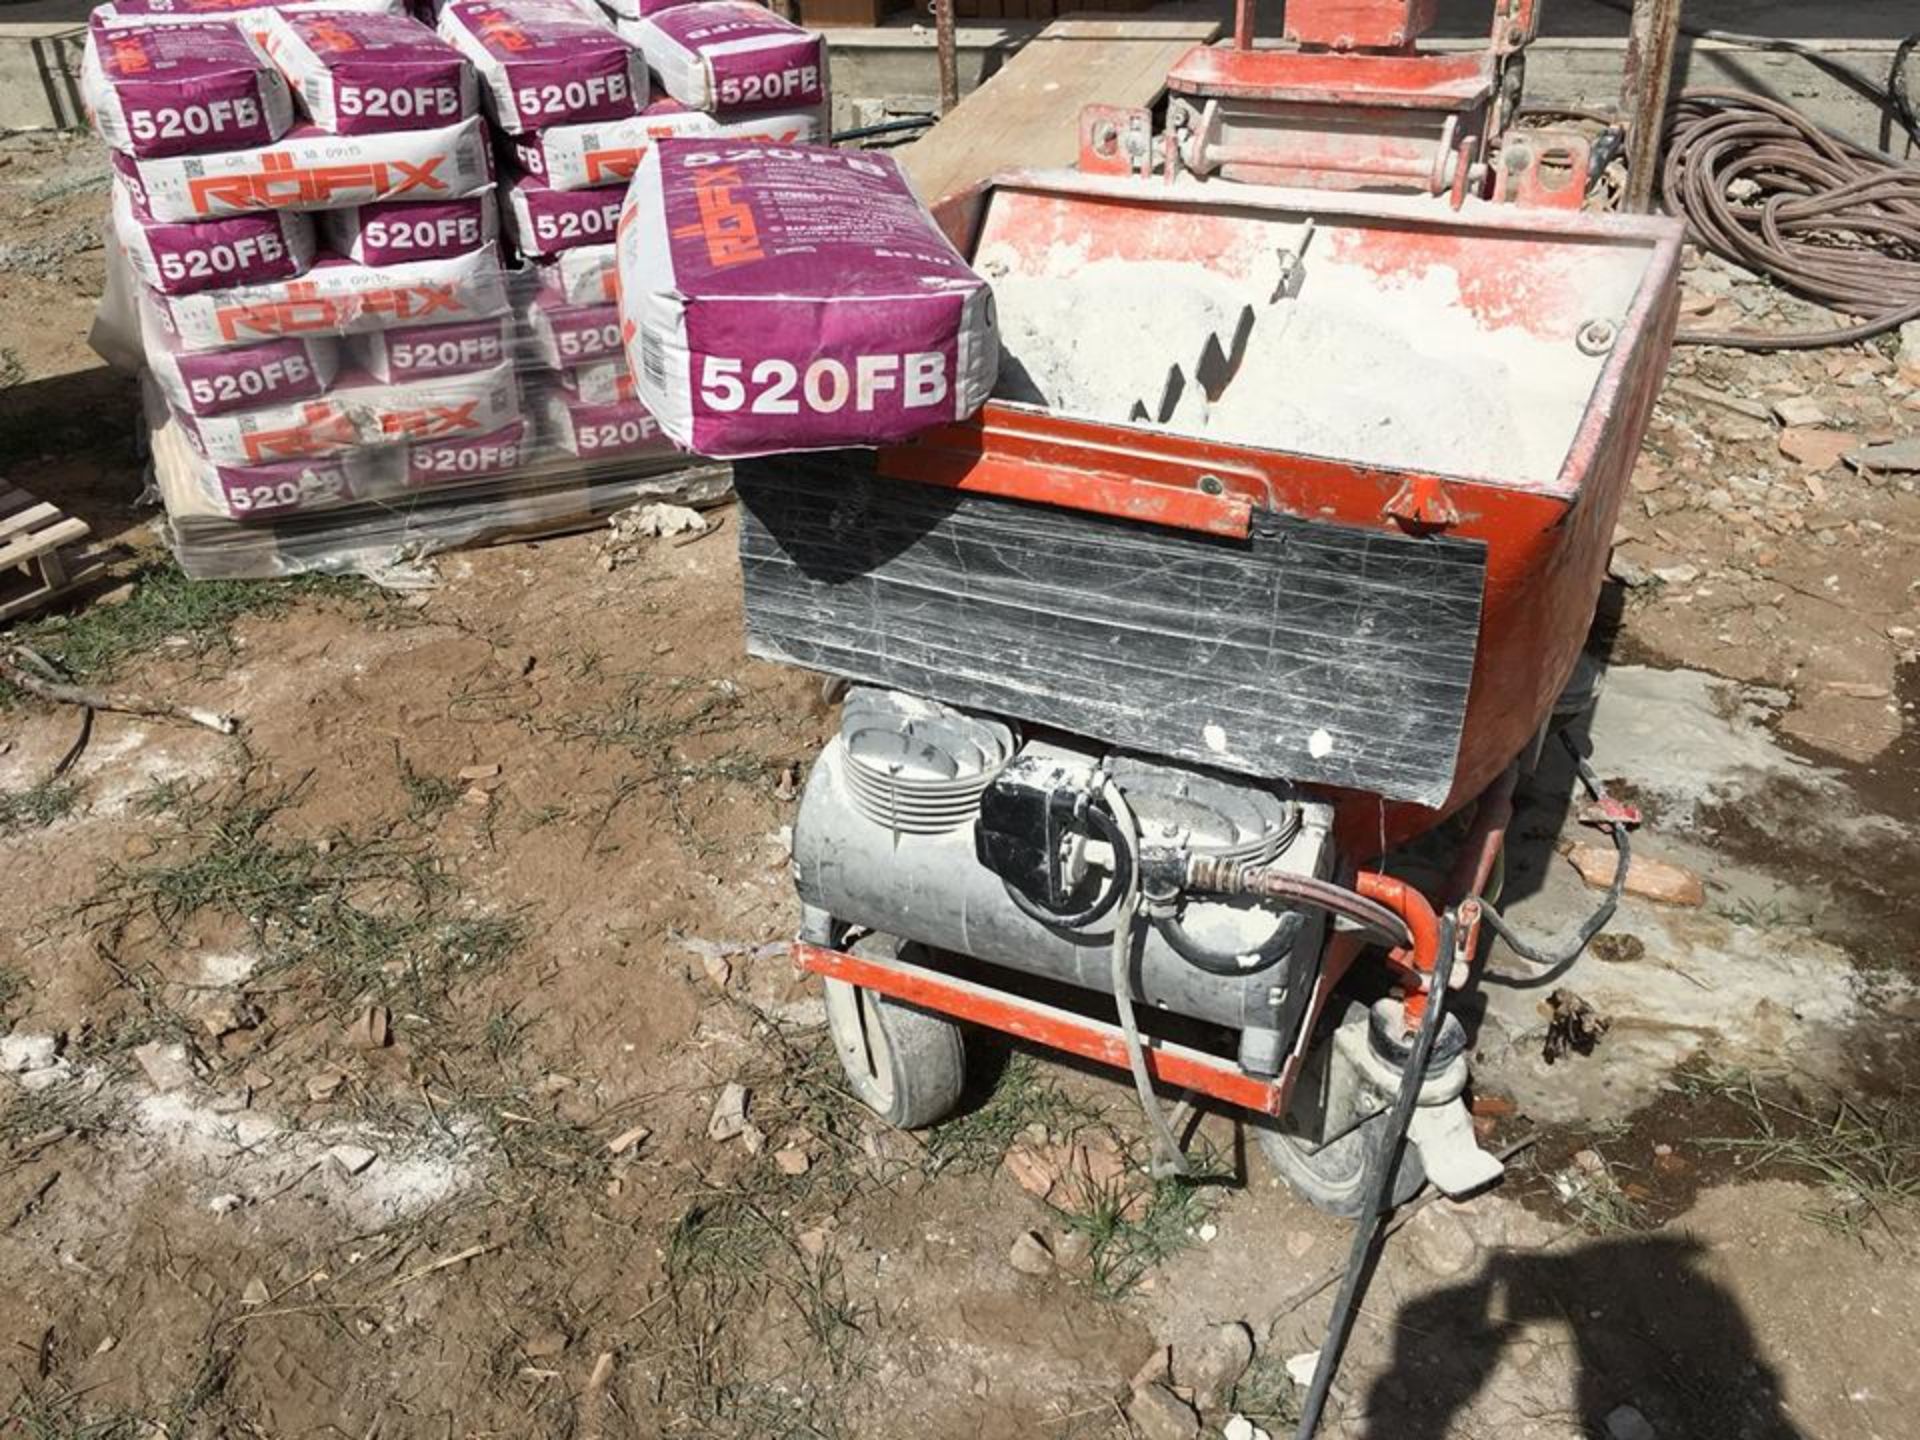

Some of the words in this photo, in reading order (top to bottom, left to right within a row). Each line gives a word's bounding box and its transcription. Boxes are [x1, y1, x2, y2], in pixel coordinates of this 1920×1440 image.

[340, 87, 459, 117] 520FB
[519, 73, 628, 115] 520FB
[722, 66, 817, 104] 520FB
[131, 98, 260, 140] 520FB
[366, 217, 480, 248] 520FB
[537, 204, 620, 240] 520F
[160, 233, 283, 280] 520FB
[392, 335, 498, 369] 520FB
[560, 324, 620, 355] 520
[191, 354, 310, 403] 520FB
[701, 352, 948, 415] 520FB
[579, 415, 656, 449] 520F
[413, 444, 518, 472] 520FB
